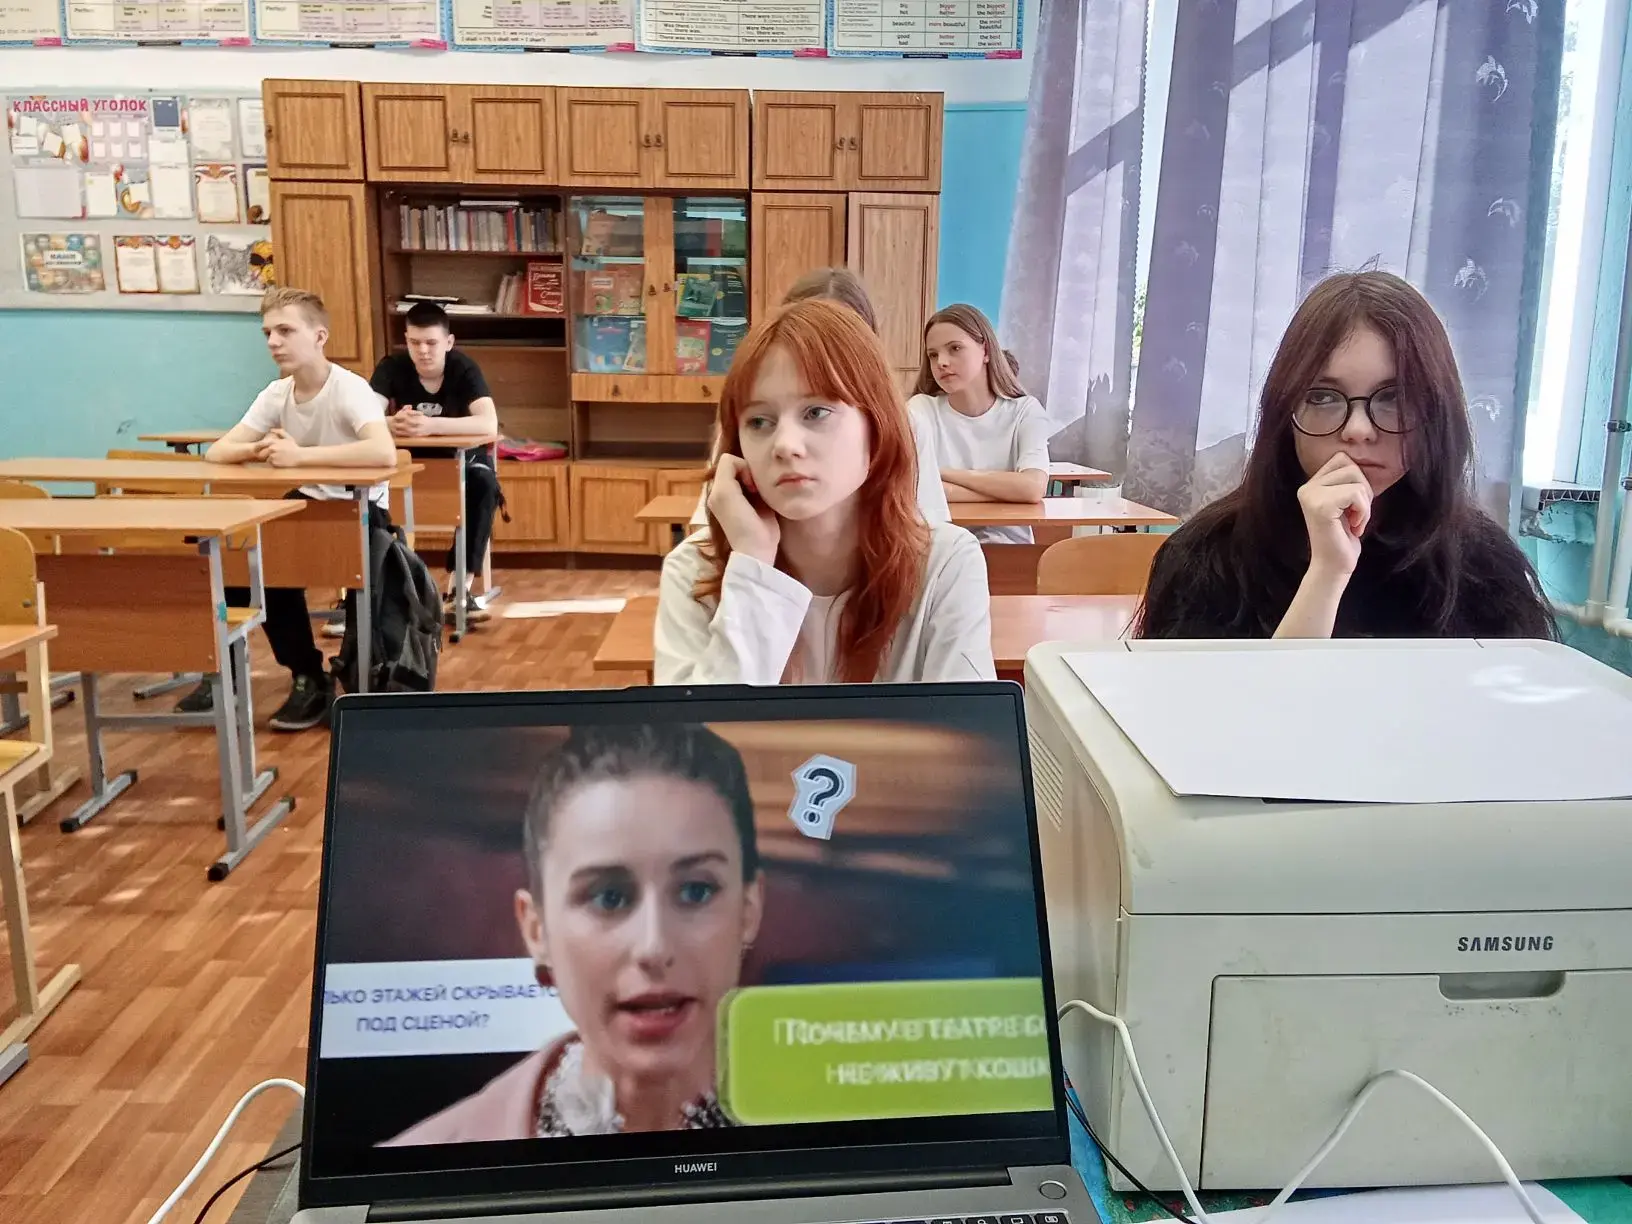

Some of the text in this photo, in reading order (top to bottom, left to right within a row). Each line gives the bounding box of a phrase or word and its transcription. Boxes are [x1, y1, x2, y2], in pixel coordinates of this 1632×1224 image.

[13, 98, 148, 112] КЛАССНЫЙ УГОЛОК
[1457, 936, 1554, 952] SAMSUNG
[372, 985, 448, 1004] ЭТАЖЕЙ
[356, 1012, 490, 1032] ПОД СЦЕНОЙ?
[674, 1162, 718, 1174] HUAWEI
